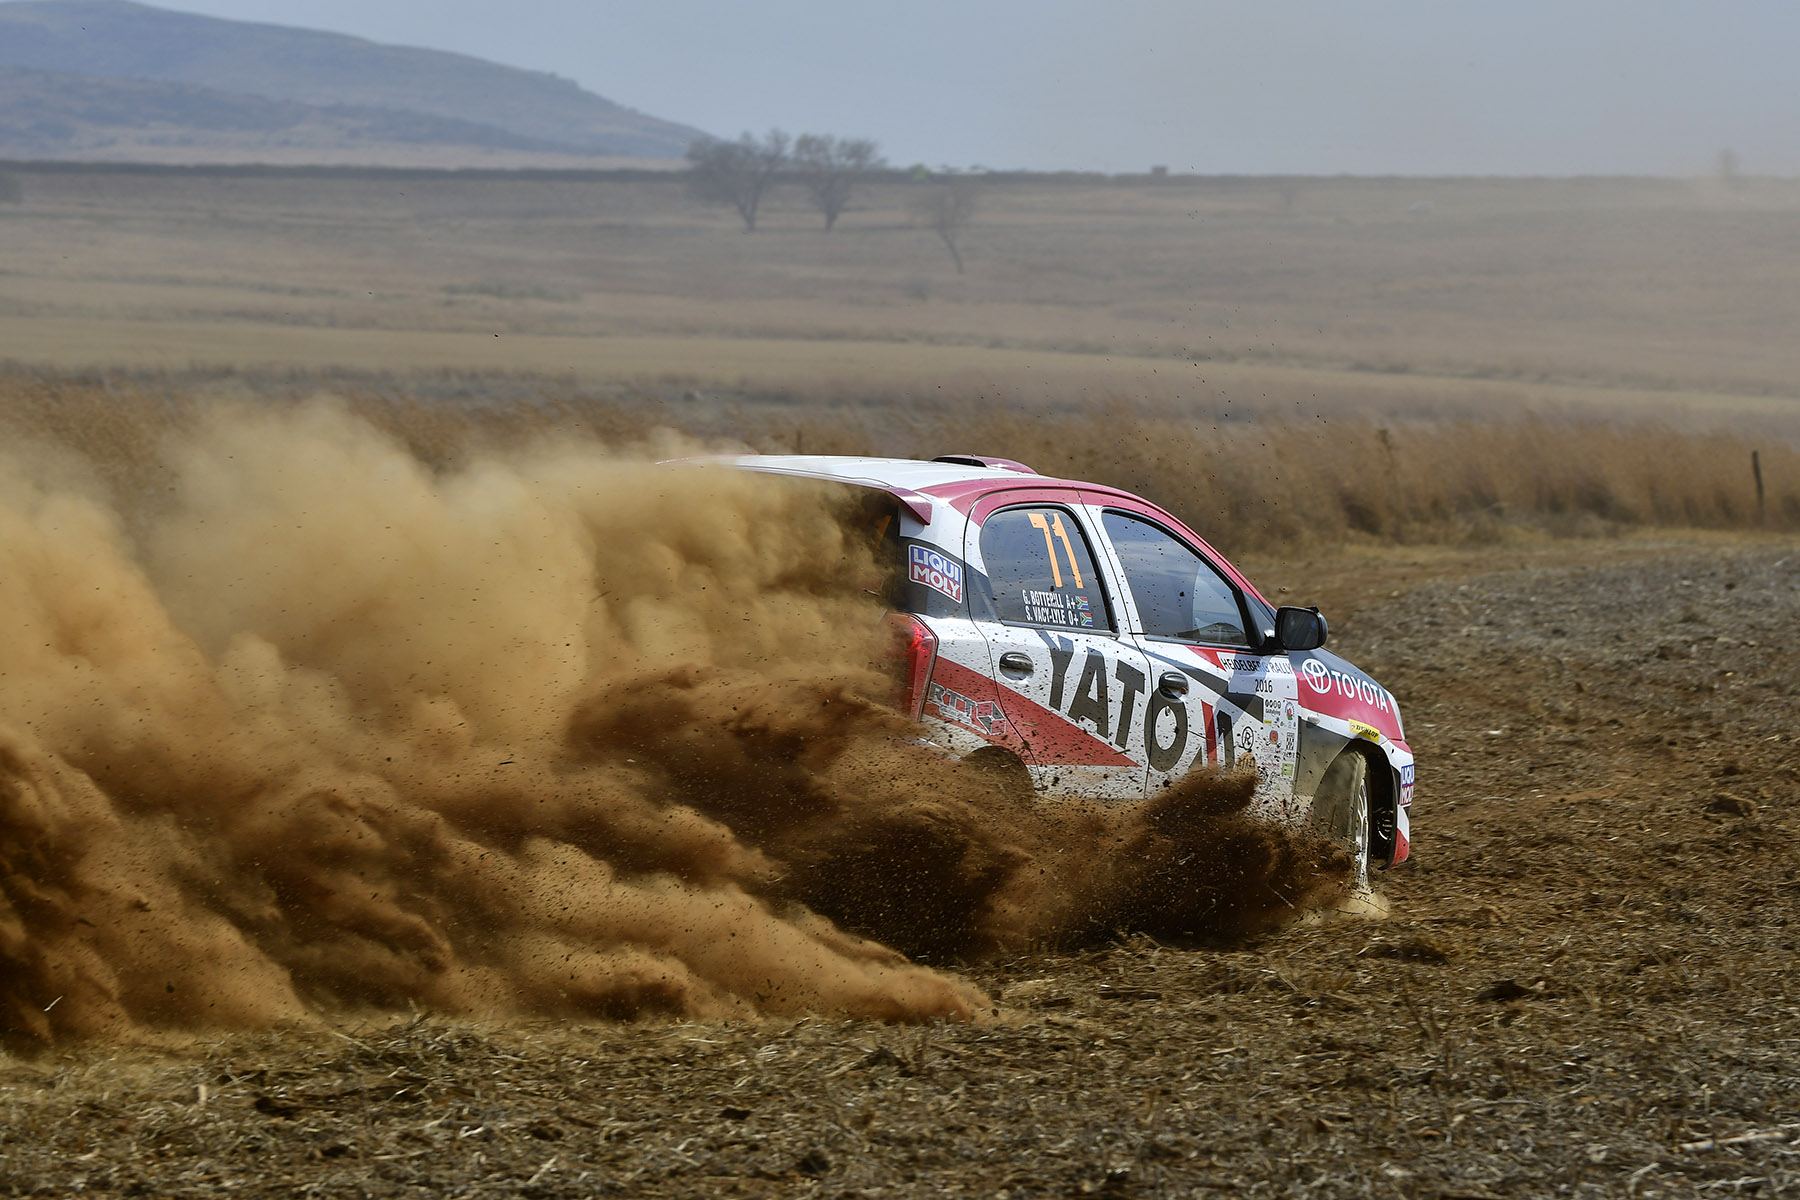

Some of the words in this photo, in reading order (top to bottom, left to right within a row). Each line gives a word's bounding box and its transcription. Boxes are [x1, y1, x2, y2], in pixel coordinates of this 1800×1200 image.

[914, 548, 959, 580] LIQUI
[1027, 513, 1083, 588] 71
[914, 566, 960, 602] MOLY
[1022, 589, 1031, 604] G.
[1025, 605, 1033, 621] S.
[1032, 606, 1066, 624] VACY-LYLE
[1269, 662, 1293, 675] RALLY
[1036, 630, 1188, 772] YATO
[1255, 678, 1273, 693] 2016
[1330, 670, 1389, 714] TOYOTA
